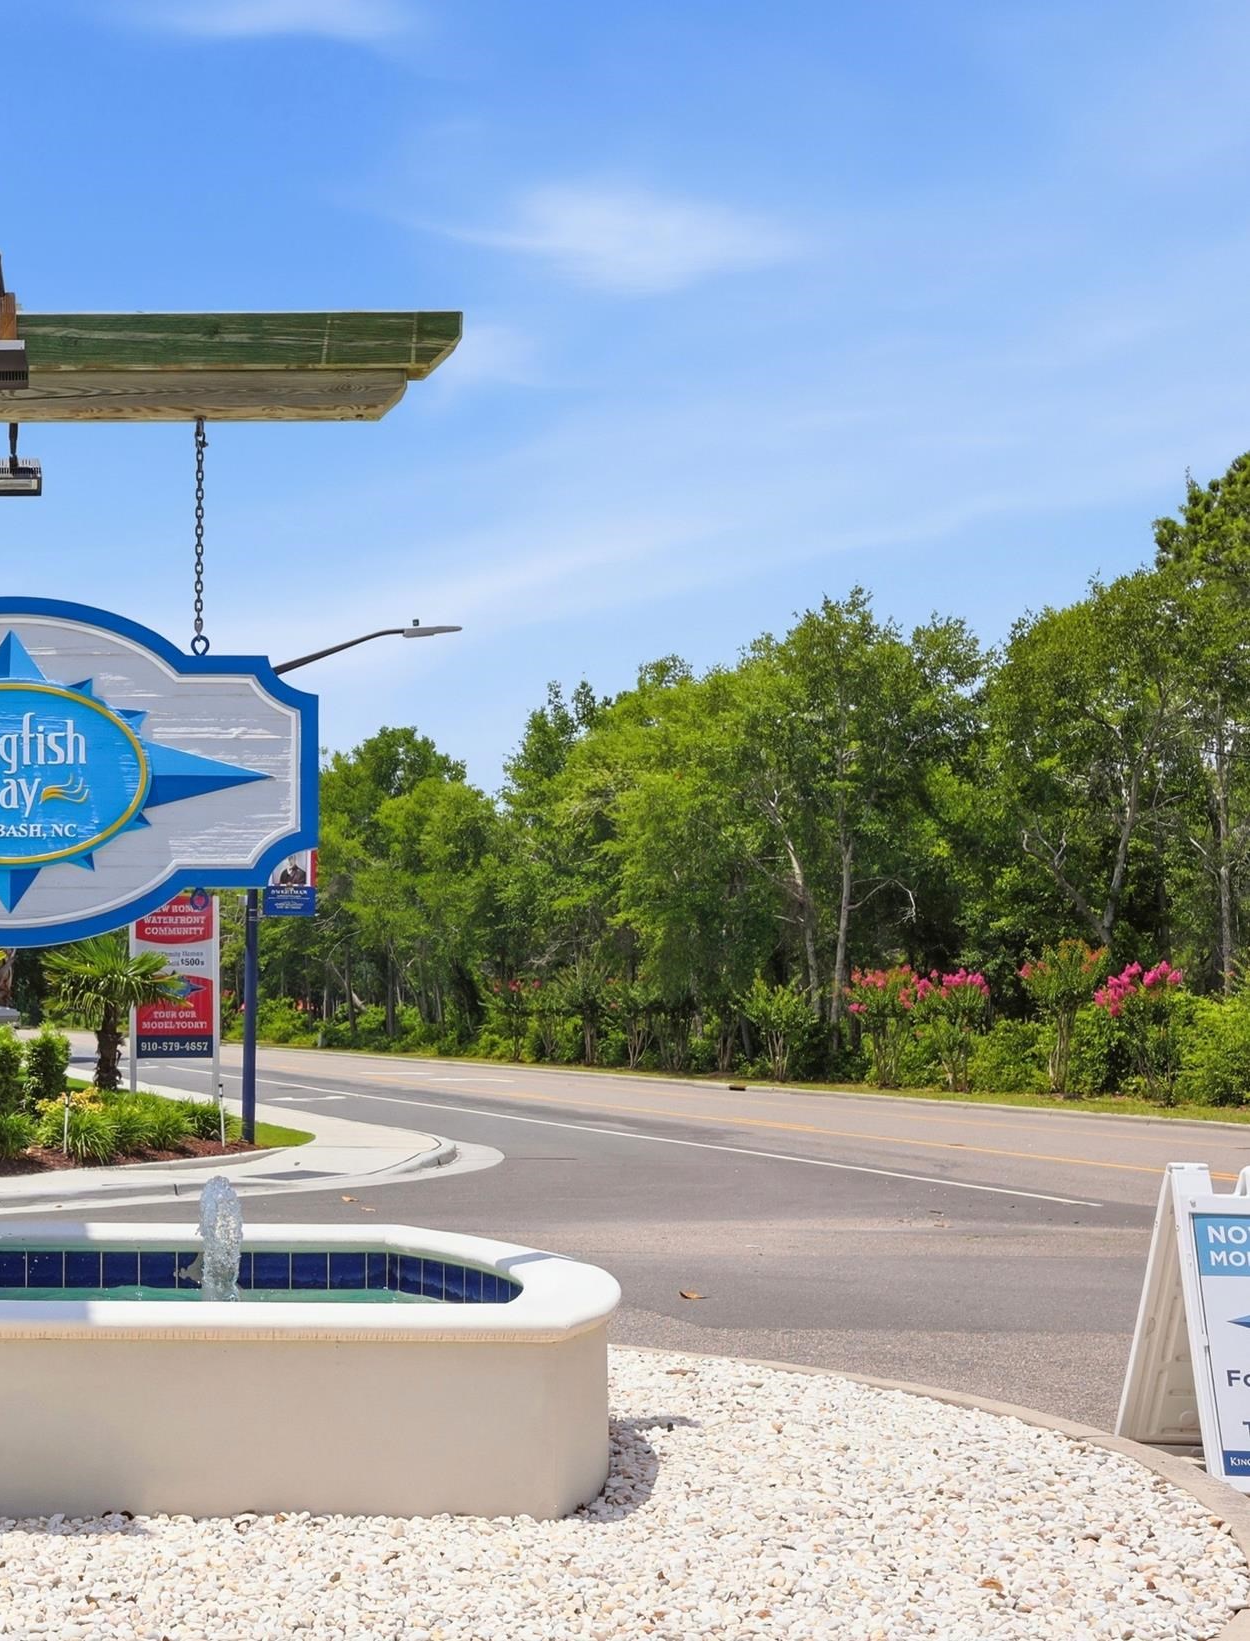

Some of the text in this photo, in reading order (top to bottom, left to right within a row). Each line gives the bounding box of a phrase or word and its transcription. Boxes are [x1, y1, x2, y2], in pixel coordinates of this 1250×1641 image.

[50, 823, 77, 838] NC
[144, 915, 206, 924] WATERFRONT
[144, 926, 205, 935] COMMUNITY
[153, 1010, 197, 1019] TOUR OUR
[142, 1021, 174, 1029] MODEL
[1207, 1225, 1250, 1245] NO
